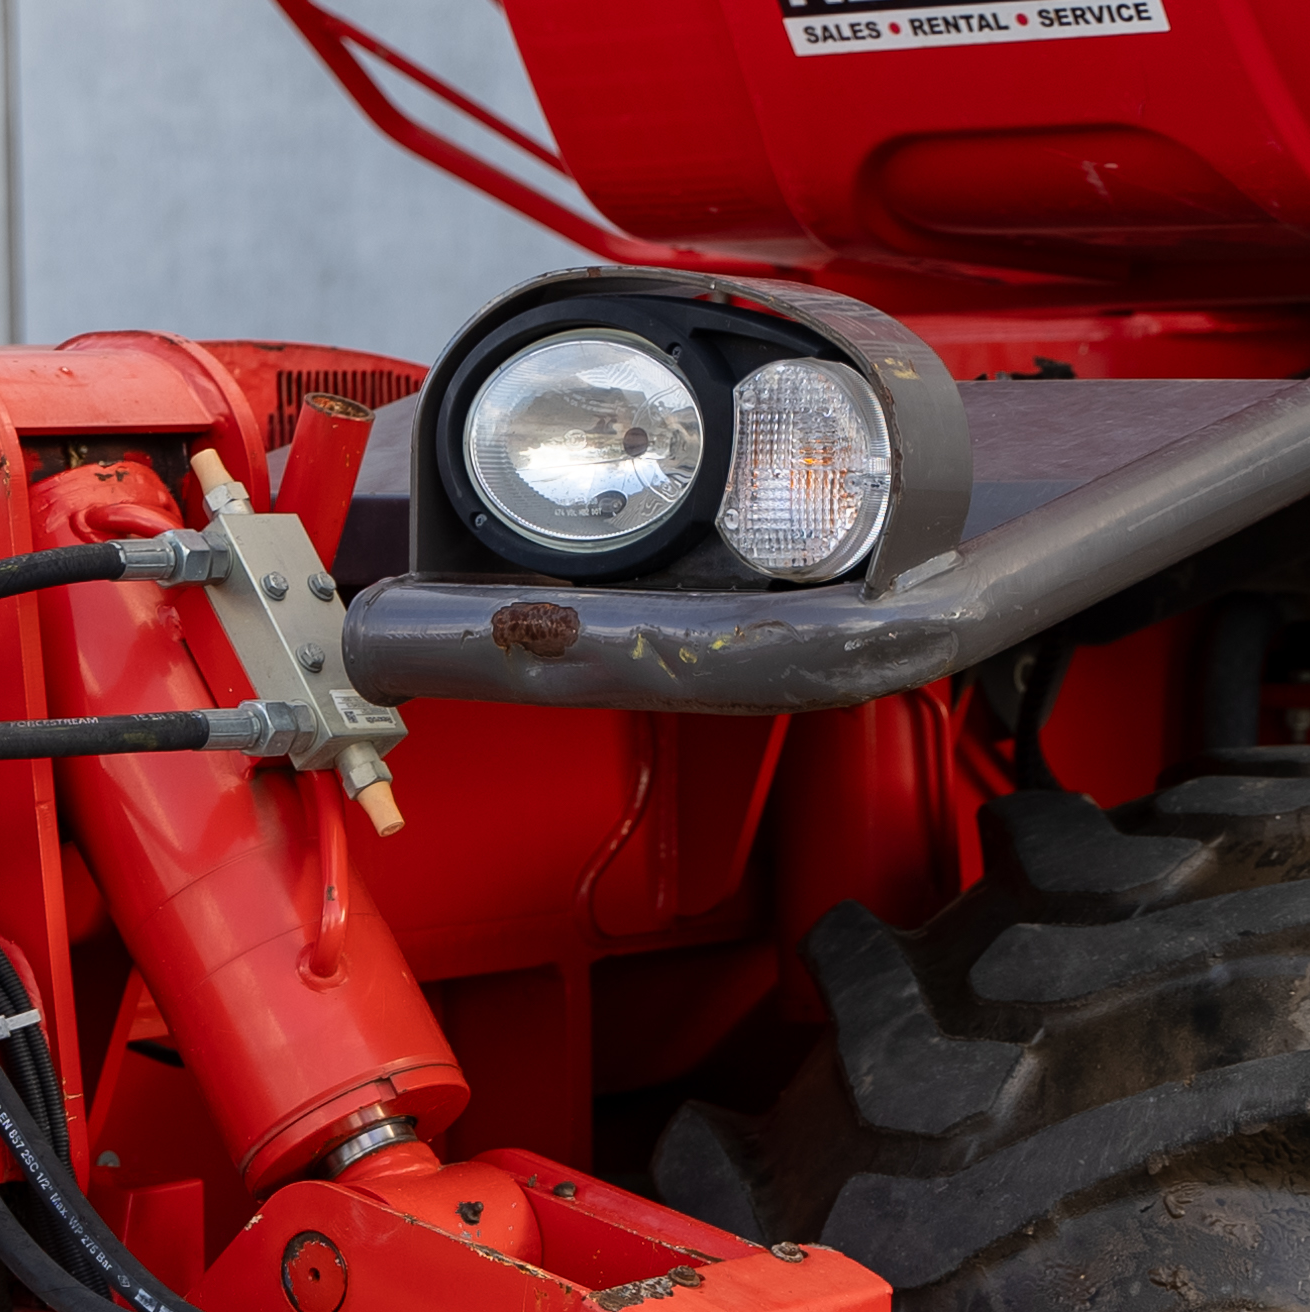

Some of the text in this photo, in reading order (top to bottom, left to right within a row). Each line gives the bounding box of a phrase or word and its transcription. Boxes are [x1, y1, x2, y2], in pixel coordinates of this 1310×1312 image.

[803, 2, 1152, 44] SALES RENTAL SERVICE
[8, 1128, 25, 1149] 857
[20, 1149, 39, 1173] 2SC
[68, 1215, 84, 1234] WP
[95, 1251, 113, 1271] Bar
